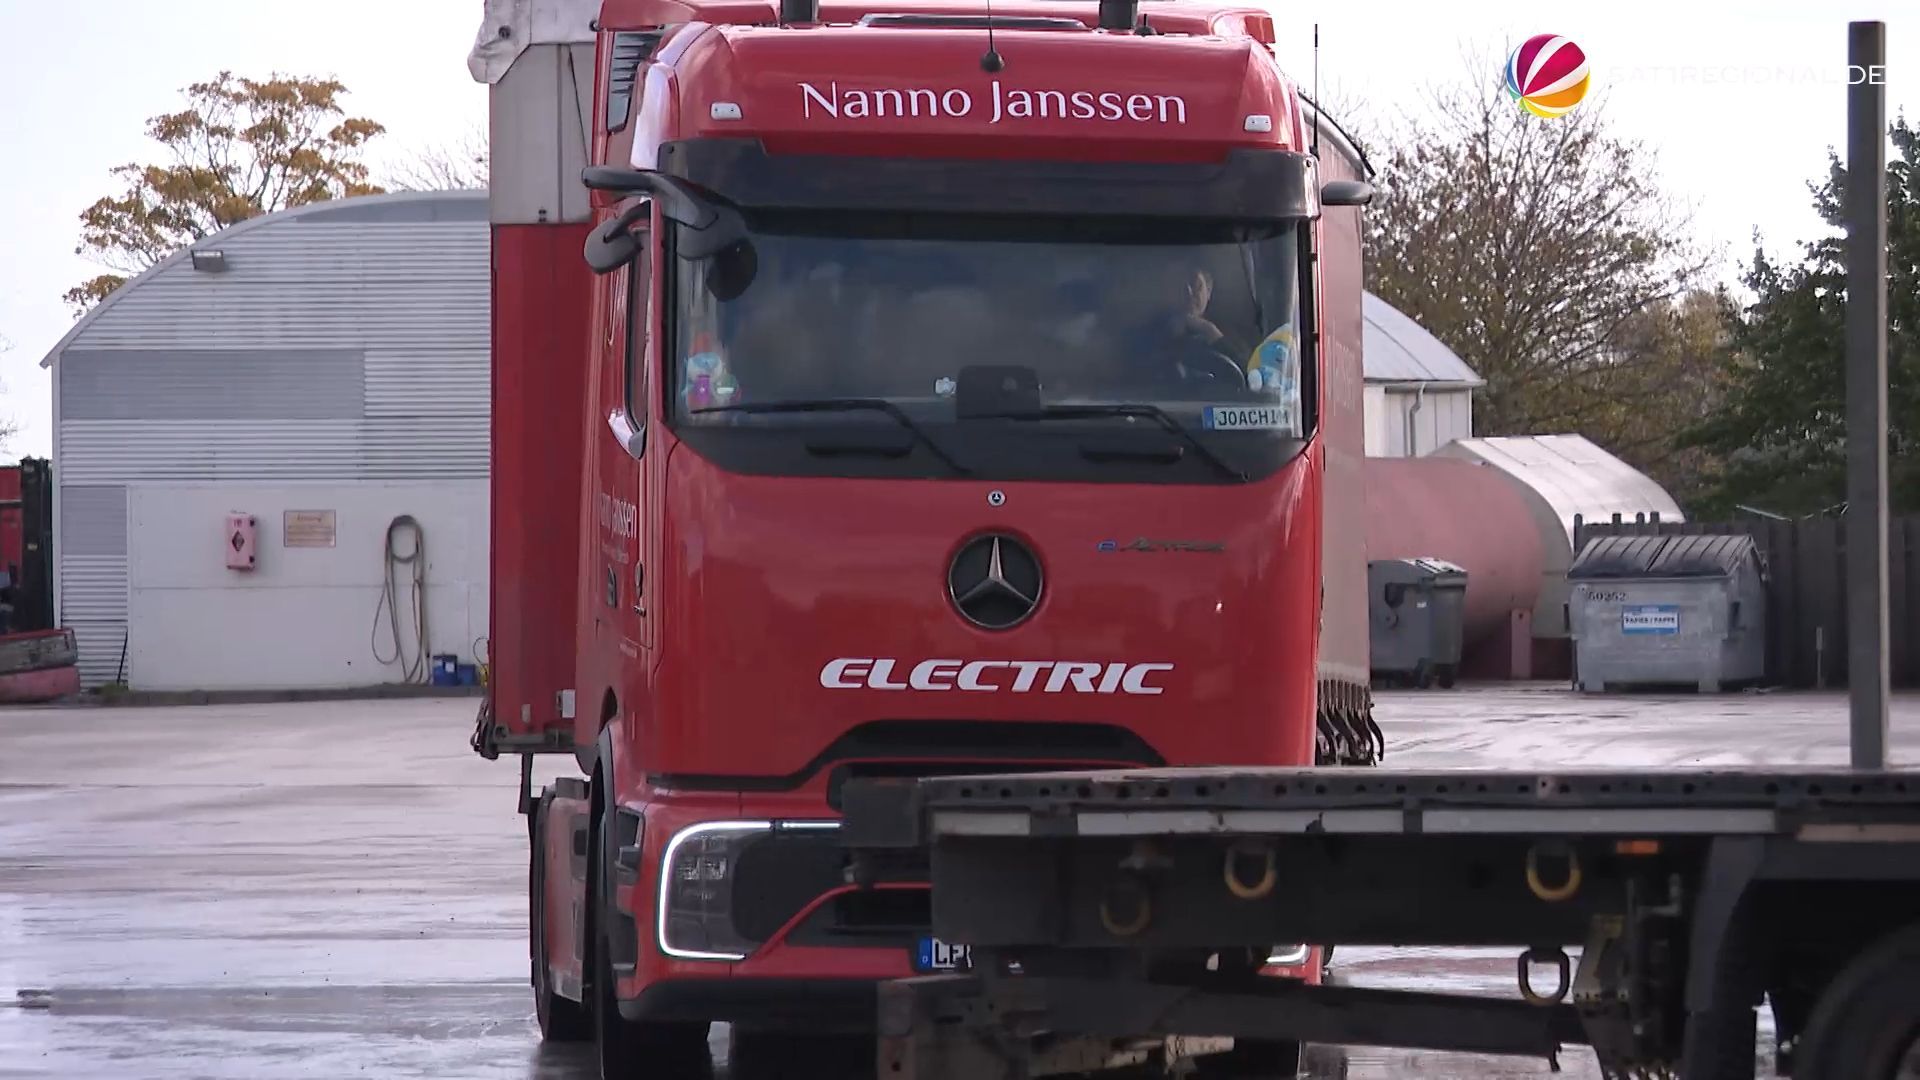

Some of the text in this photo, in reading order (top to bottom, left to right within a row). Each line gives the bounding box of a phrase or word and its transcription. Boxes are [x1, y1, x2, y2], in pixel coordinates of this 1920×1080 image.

[798, 80, 1187, 124] Nanno Janssen
[820, 658, 1174, 694] ELECTRIC
